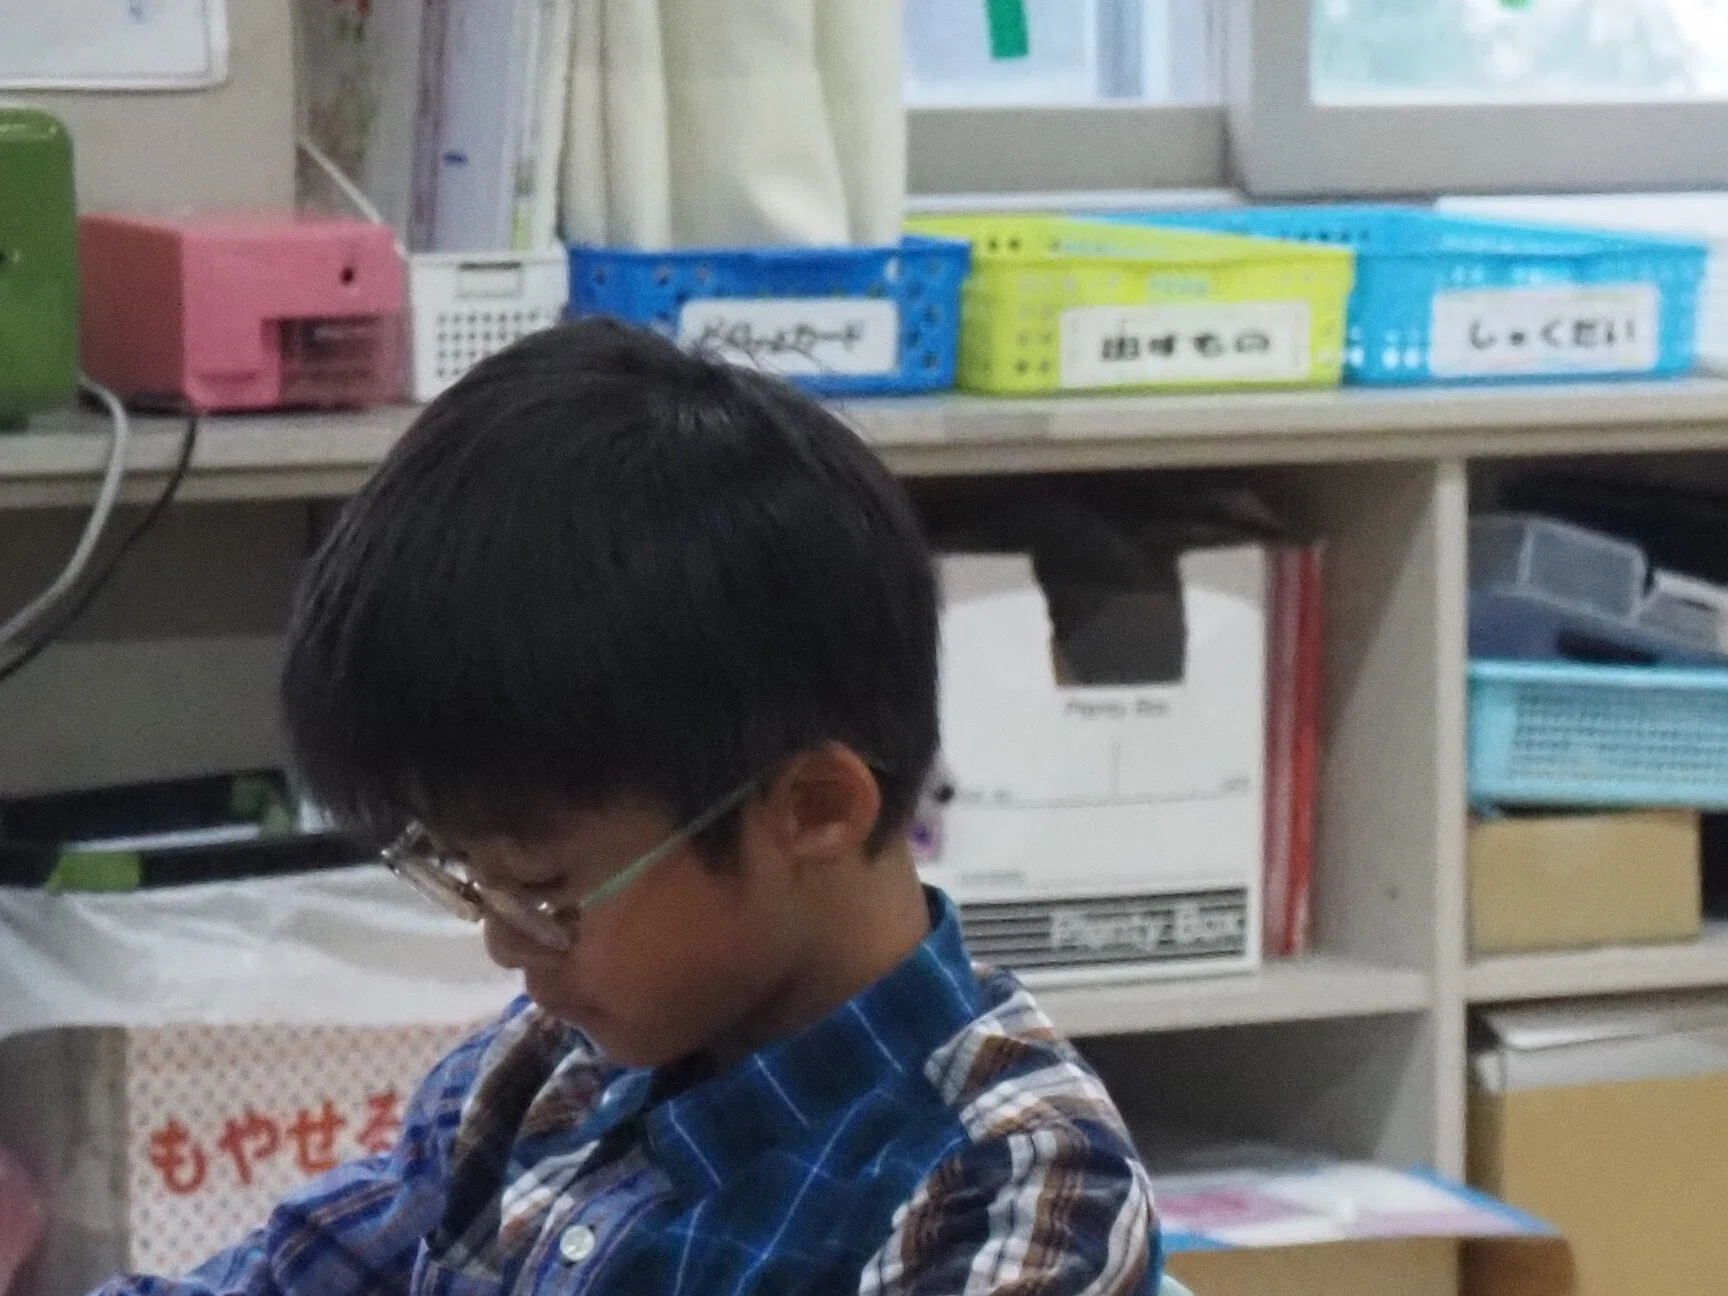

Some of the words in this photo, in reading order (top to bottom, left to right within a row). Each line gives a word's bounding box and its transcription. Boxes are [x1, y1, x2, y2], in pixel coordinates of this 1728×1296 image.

[1468, 314, 1638, 351] しゅくだい
[1050, 907, 1172, 953] Plenty
[1174, 902, 1247, 946] Box
[150, 1090, 402, 1194] もやせる
